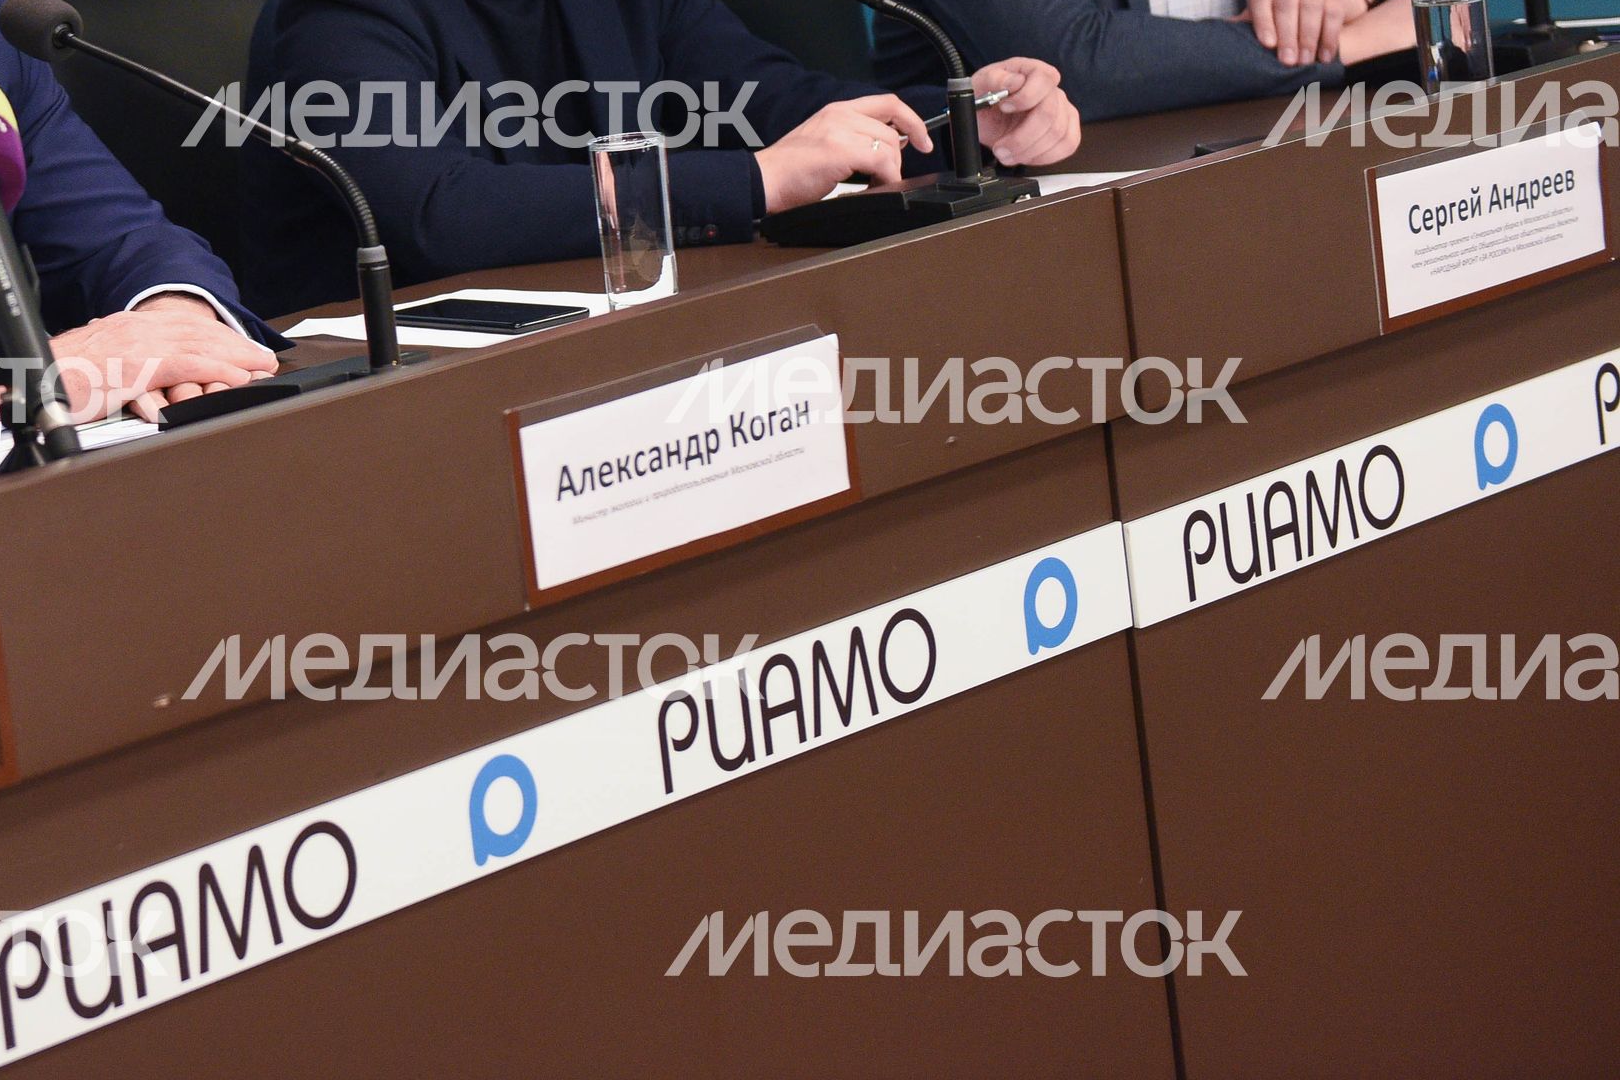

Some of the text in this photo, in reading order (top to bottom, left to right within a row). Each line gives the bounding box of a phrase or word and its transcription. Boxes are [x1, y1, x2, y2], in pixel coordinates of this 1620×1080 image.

[1409, 186, 1481, 235] Сергей
[1489, 169, 1575, 213] Андреев
[556, 428, 720, 501] Александр
[728, 400, 811, 447] Коган
